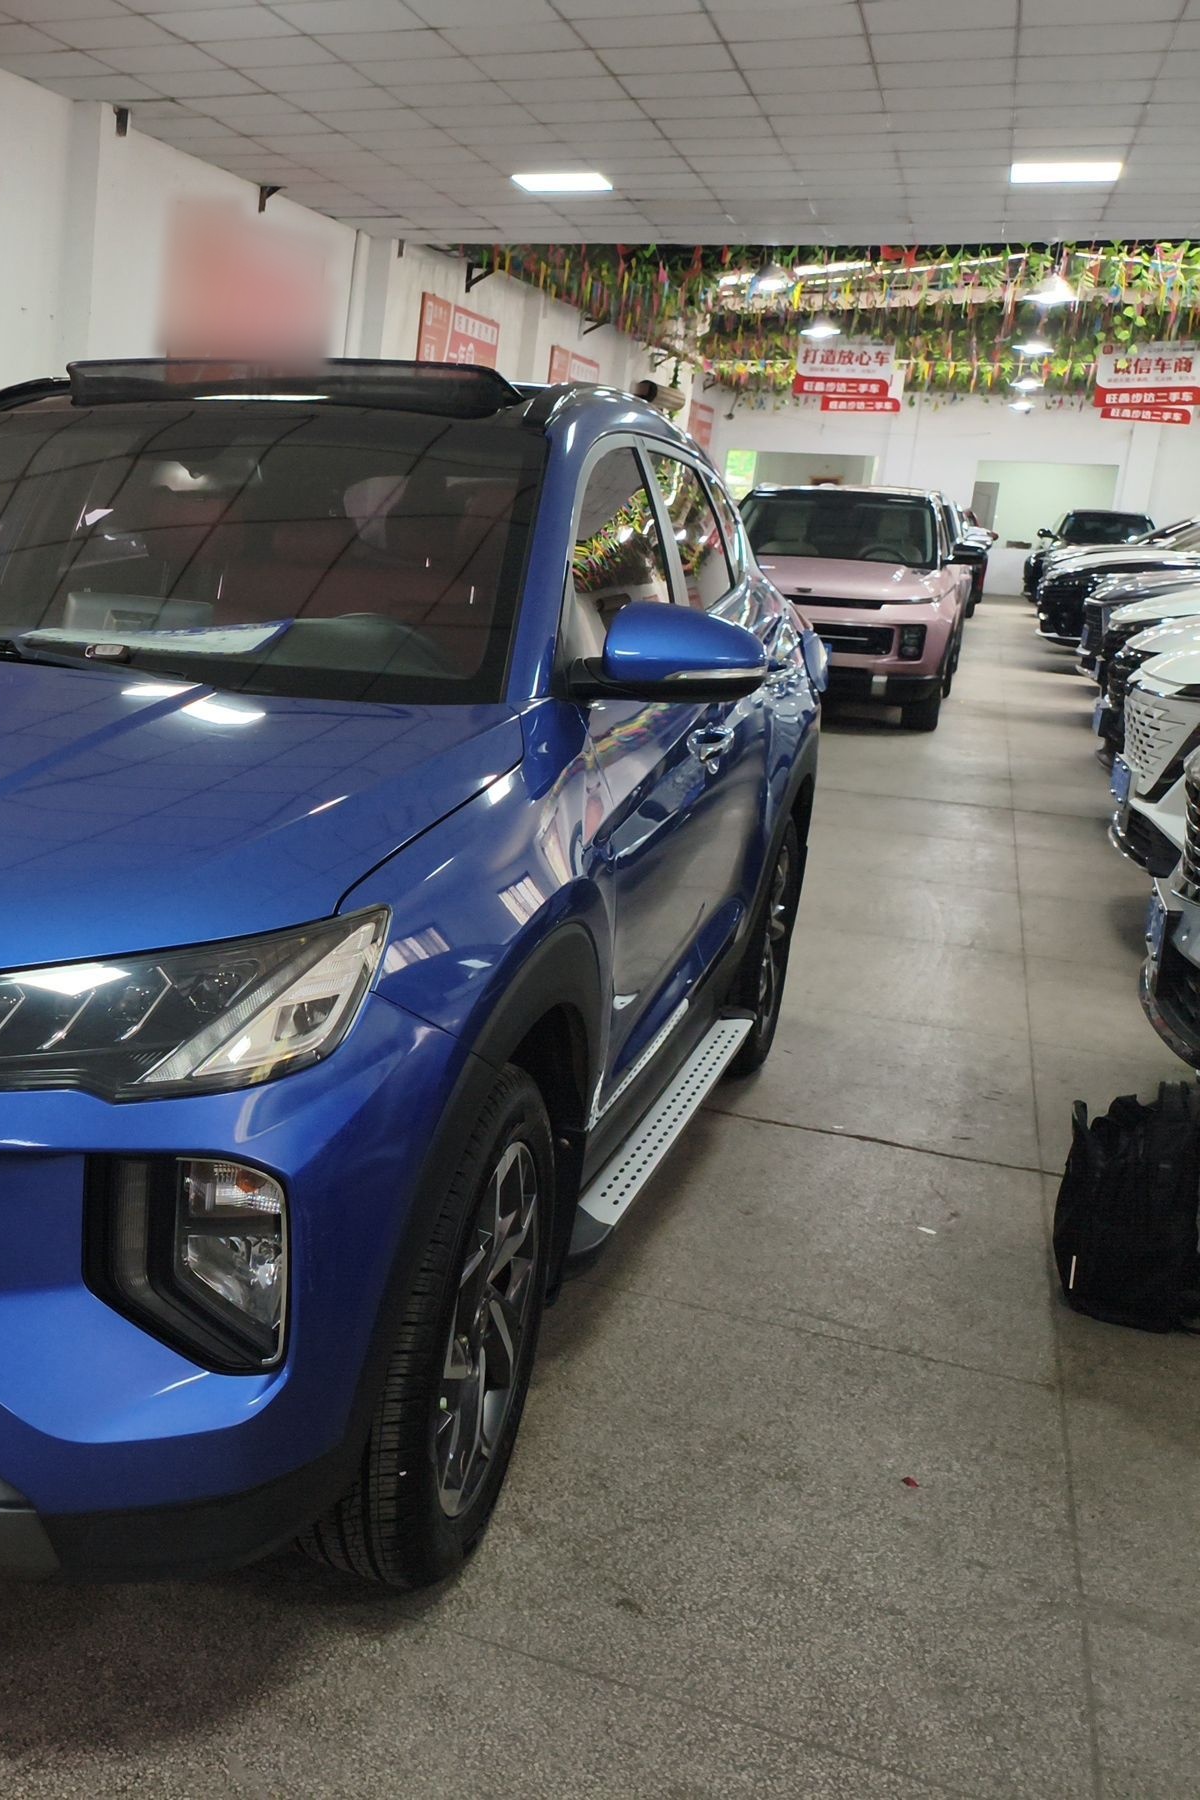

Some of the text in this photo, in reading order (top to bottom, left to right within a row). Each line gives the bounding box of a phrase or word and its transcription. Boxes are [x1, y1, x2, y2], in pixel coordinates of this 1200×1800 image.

[802, 348, 890, 367] 打造放心车
[1113, 356, 1194, 375] 诚信车商
